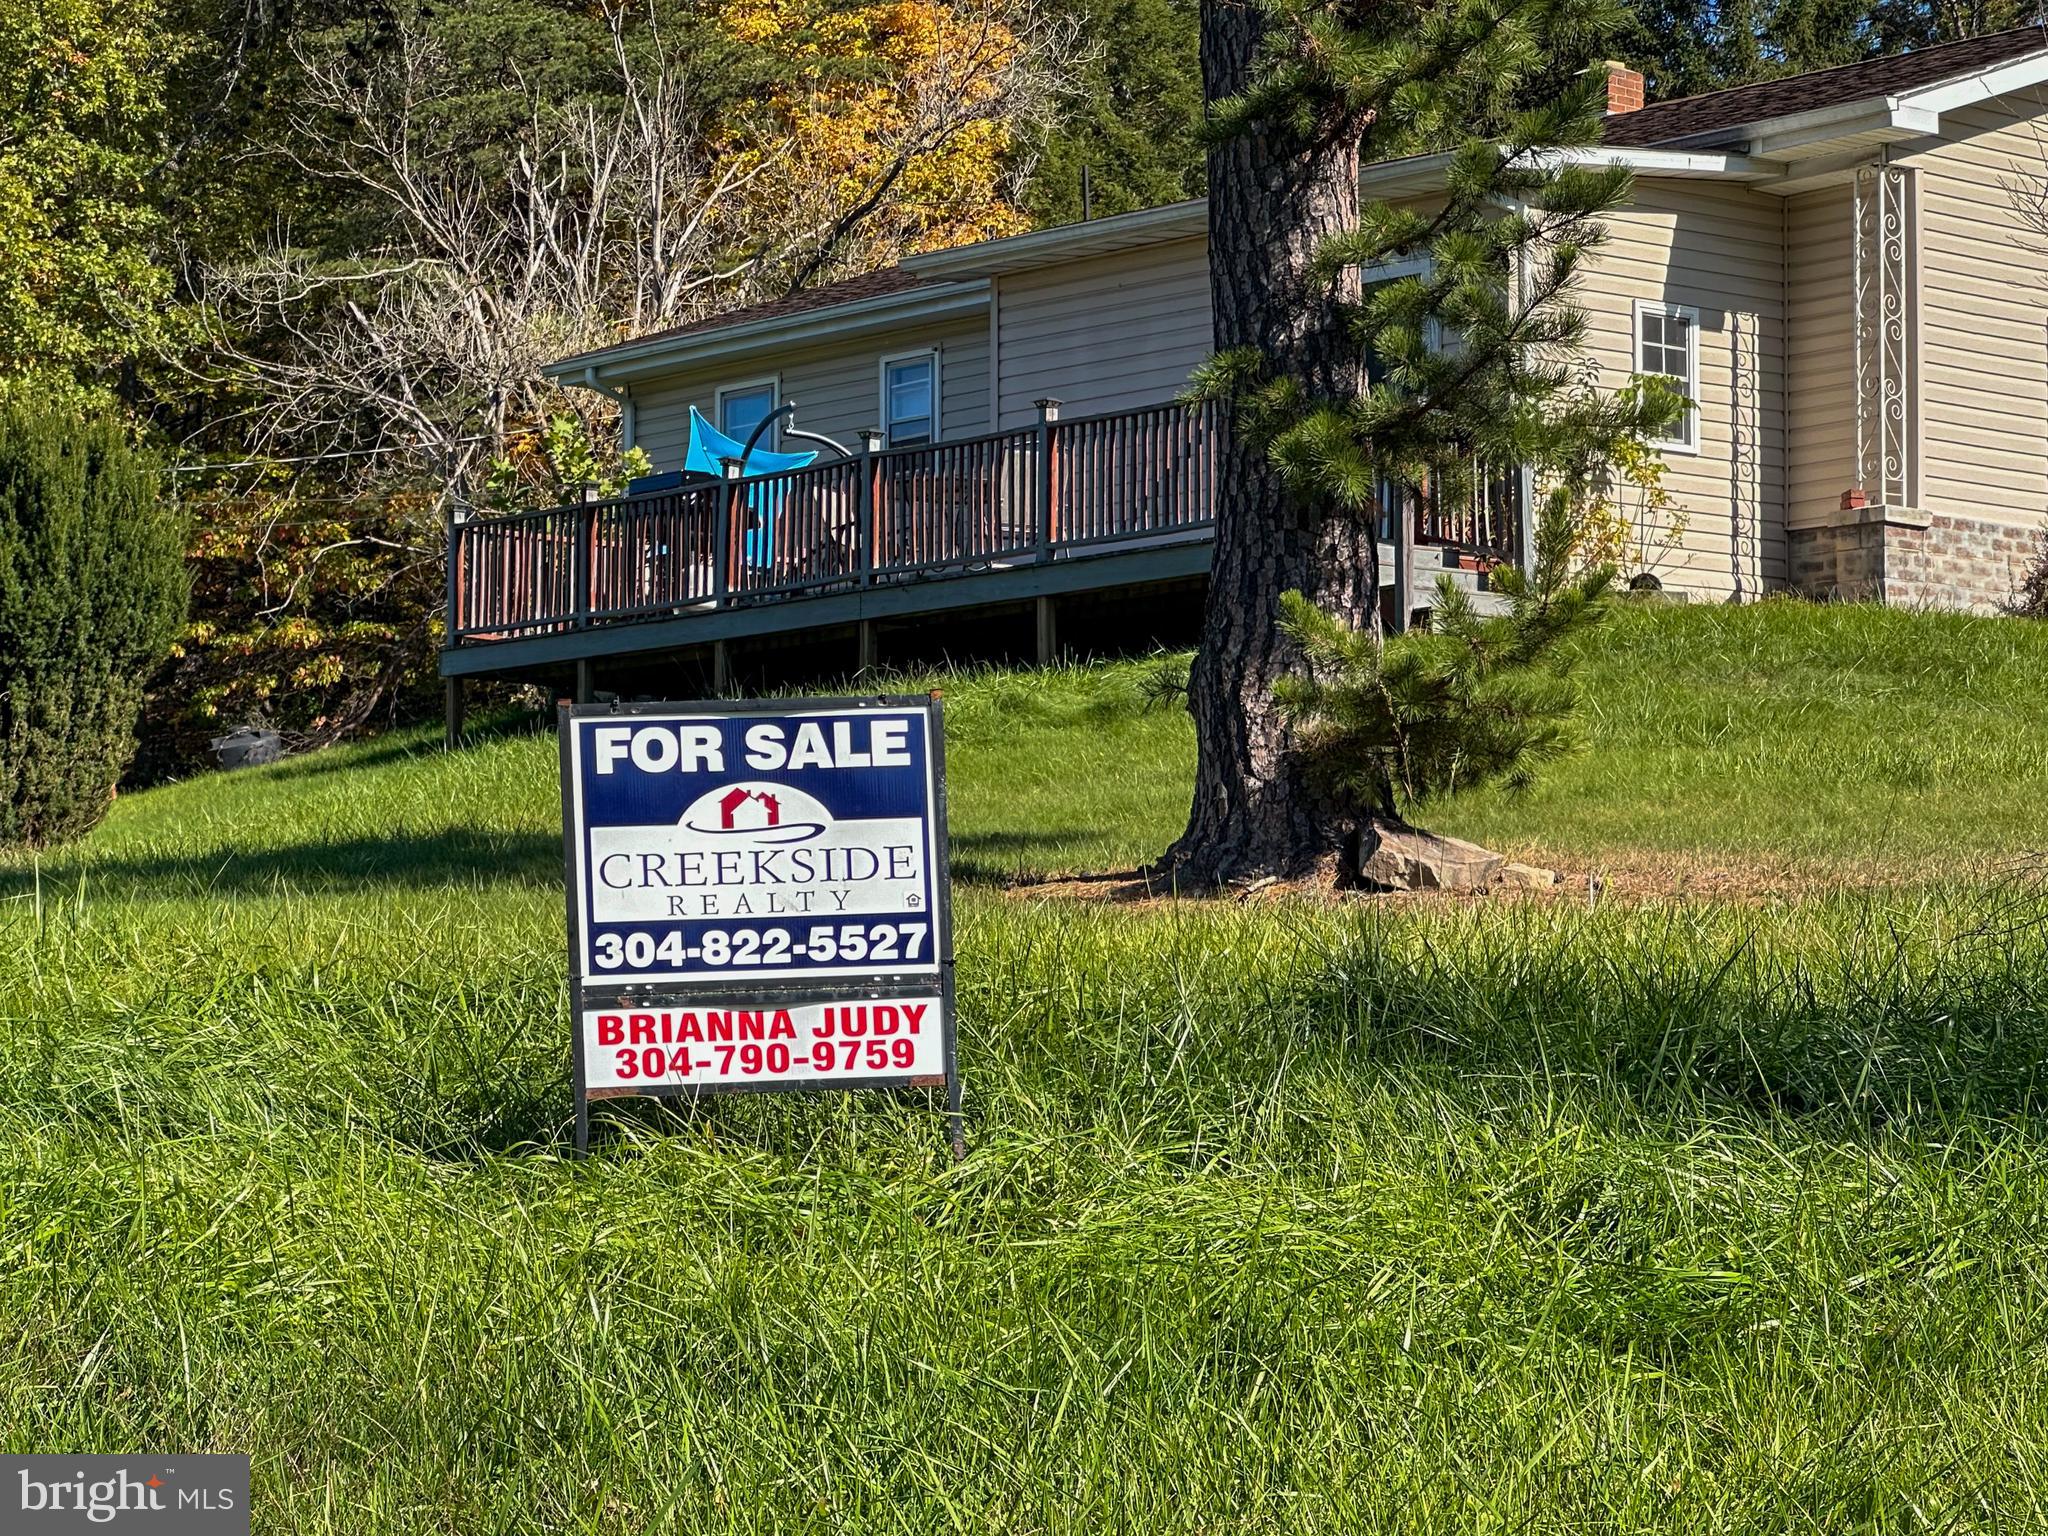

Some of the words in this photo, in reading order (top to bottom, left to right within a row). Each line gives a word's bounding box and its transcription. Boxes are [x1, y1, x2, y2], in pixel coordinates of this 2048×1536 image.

[594, 725, 725, 774] FOR
[745, 719, 911, 771] SALE
[599, 845, 917, 889] CREEKSIDE
[667, 890, 851, 916] REALTY
[594, 922, 928, 969] 304-822-5527
[597, 1009, 797, 1046] BRIANNA
[812, 1004, 928, 1038] JUDY
[615, 1038, 915, 1079] 304-790-9759
